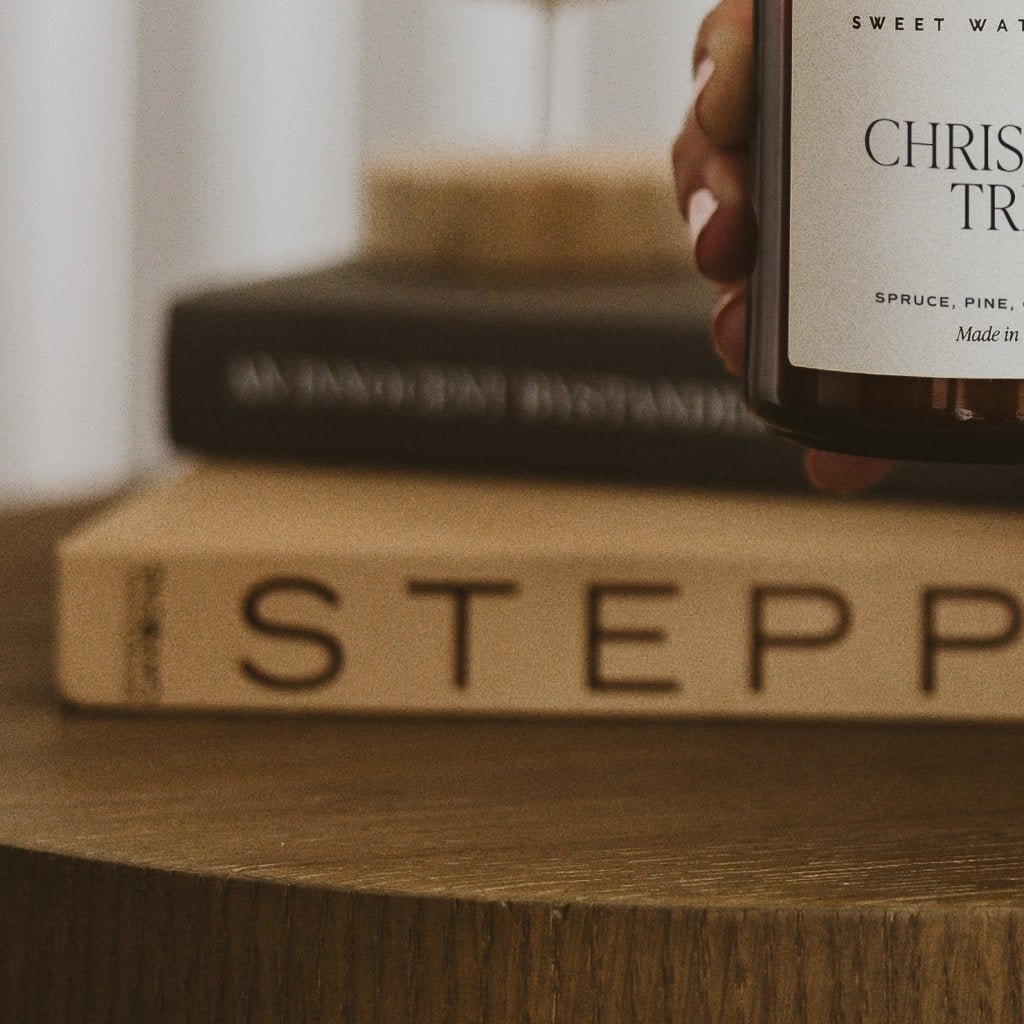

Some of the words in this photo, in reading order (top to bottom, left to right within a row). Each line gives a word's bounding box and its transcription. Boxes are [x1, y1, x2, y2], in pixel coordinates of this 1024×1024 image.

[851, 15, 945, 32] SWEET
[874, 291, 956, 309] SPRUCE,
[964, 296, 1015, 312] PINE,
[955, 325, 1001, 343] Made
[1003, 326, 1020, 343] in
